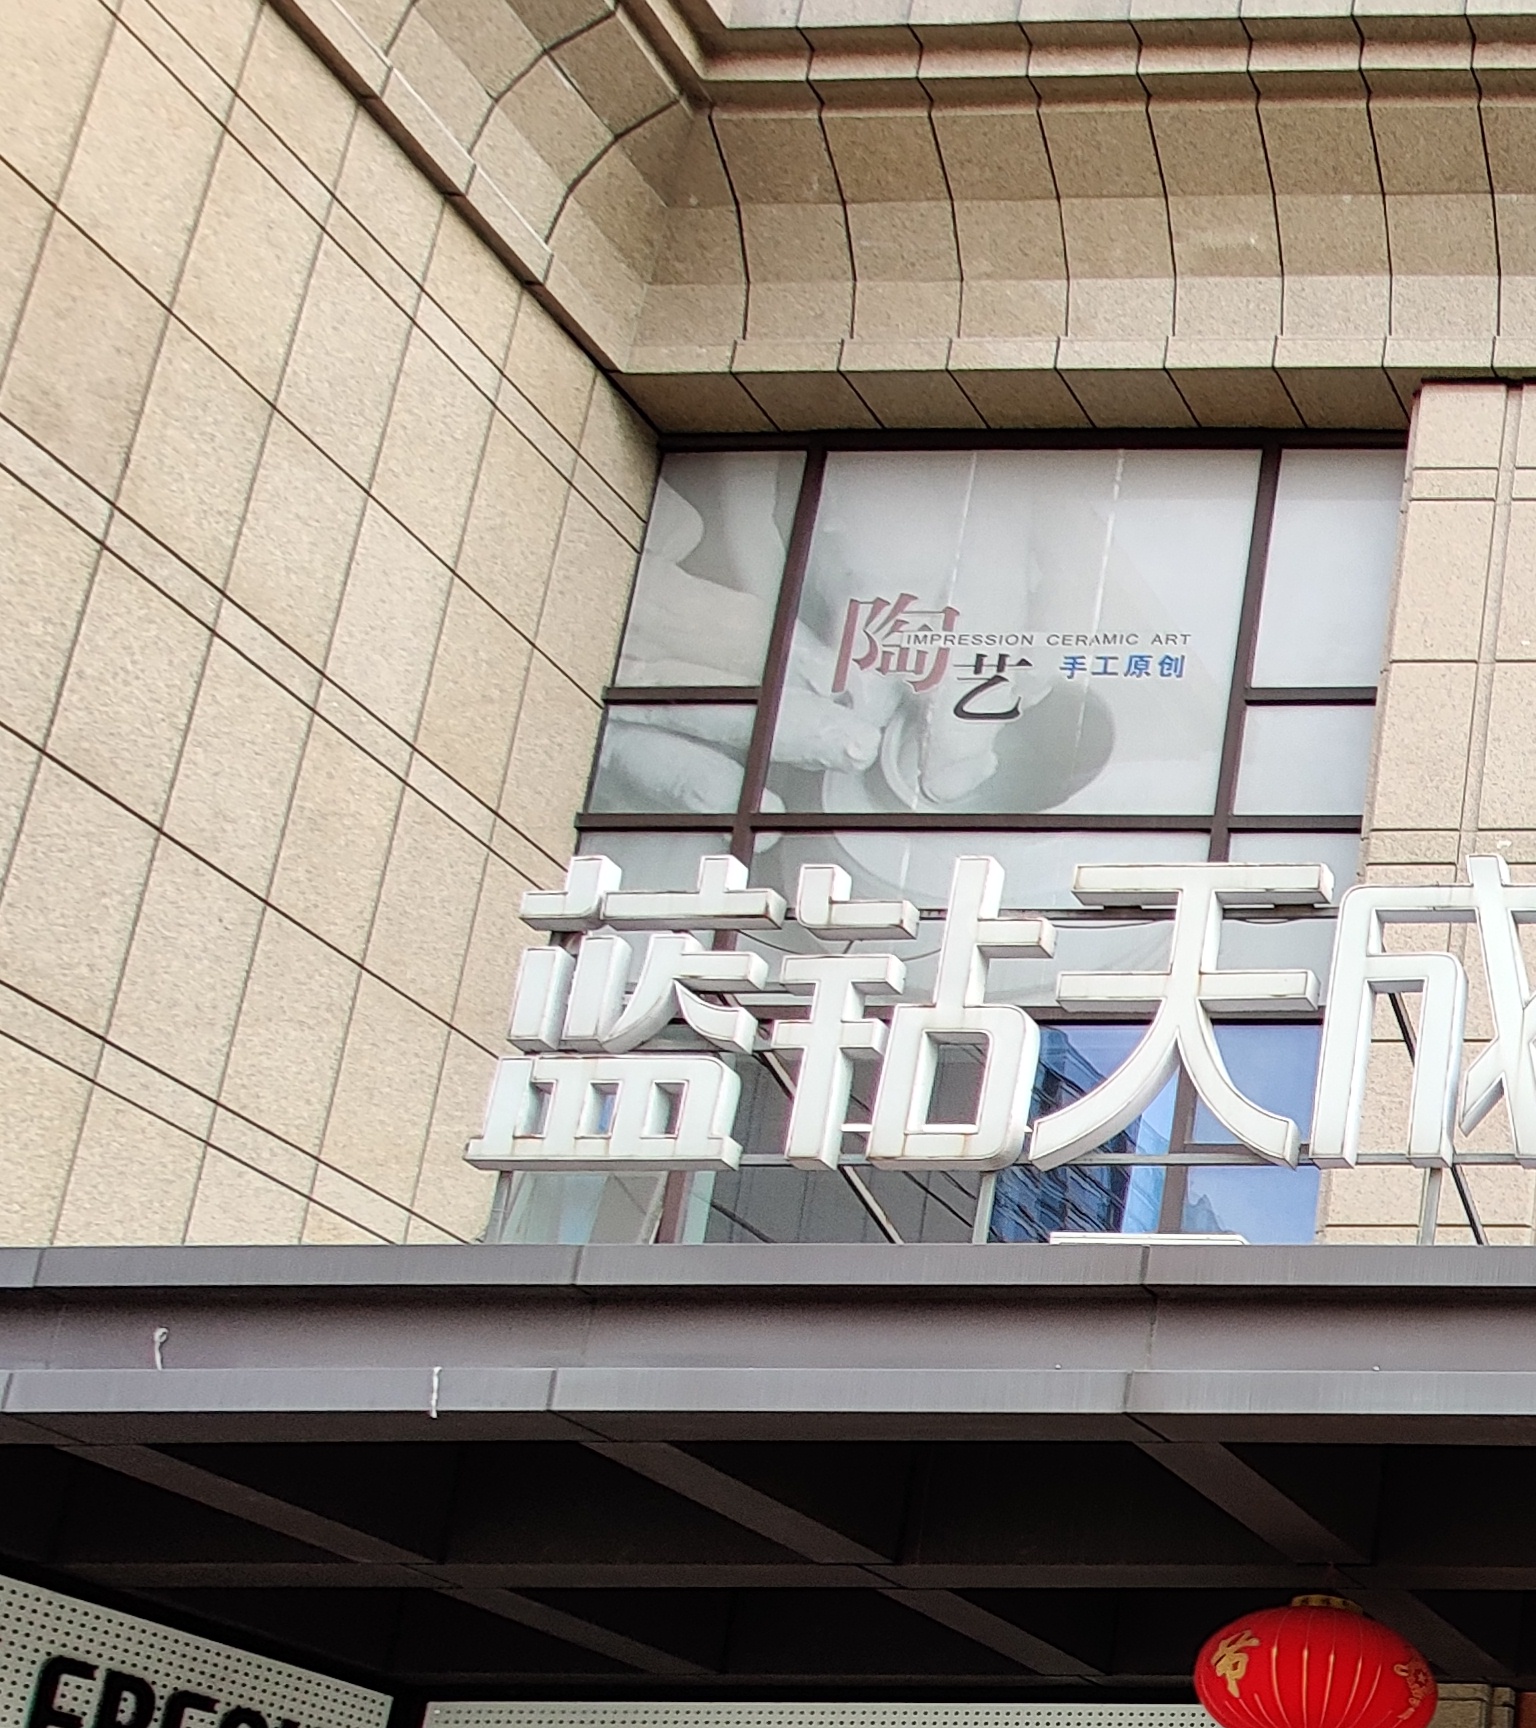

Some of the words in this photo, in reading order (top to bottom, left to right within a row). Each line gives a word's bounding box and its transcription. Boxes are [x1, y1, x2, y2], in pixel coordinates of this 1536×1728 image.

[906, 633, 1034, 647] IMPRESSION
[1046, 633, 1140, 647] CERAMIC
[1151, 633, 1193, 647] ART
[1059, 654, 1186, 681] 手工原创
